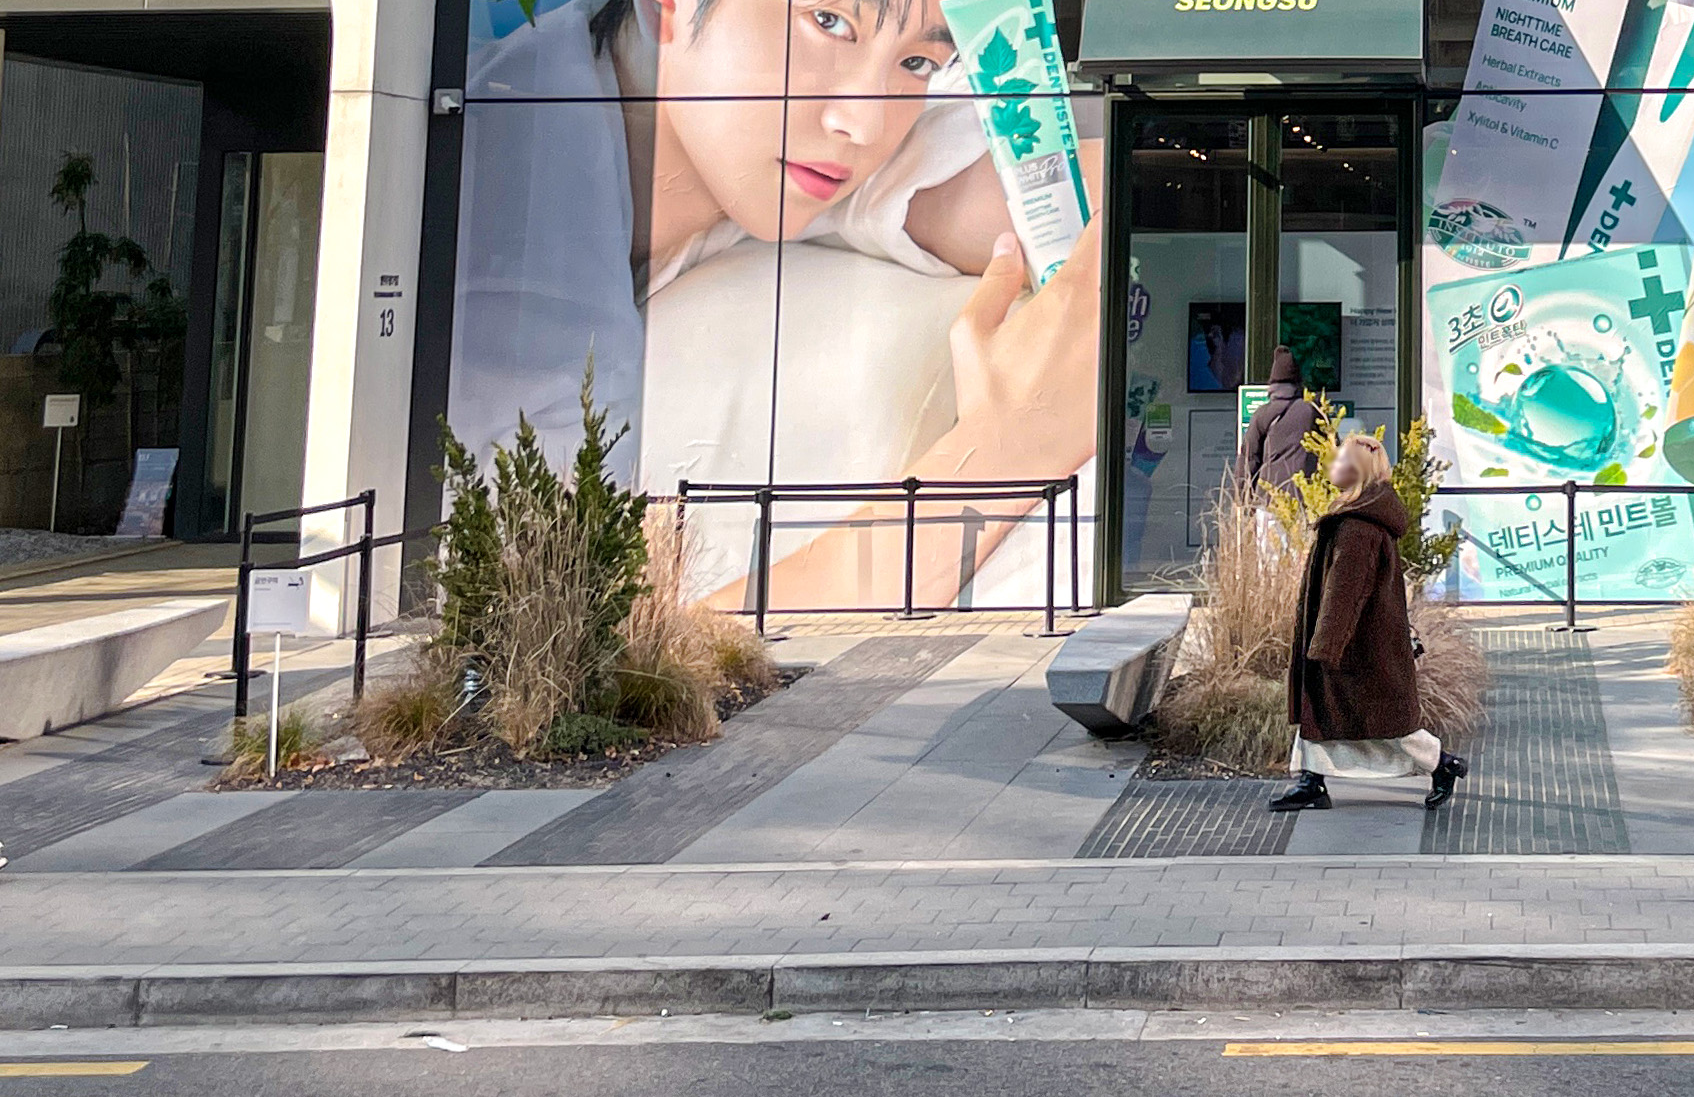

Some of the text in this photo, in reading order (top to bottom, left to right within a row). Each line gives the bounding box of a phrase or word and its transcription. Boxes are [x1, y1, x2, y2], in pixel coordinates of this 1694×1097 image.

[1495, 7, 1564, 37] NIGHTTIME
[1490, 23, 1574, 59] BREATH CARE
[1482, 54, 1562, 88] Herbal Extracts
[1466, 110, 1559, 150] Xylitol & Vitamin C
[380, 308, 395, 338] 13
[1447, 304, 1485, 344] 3초
[1487, 493, 1679, 560] 덴티스테 민트볼
[1495, 546, 1609, 579] PREMIUM QALITY
